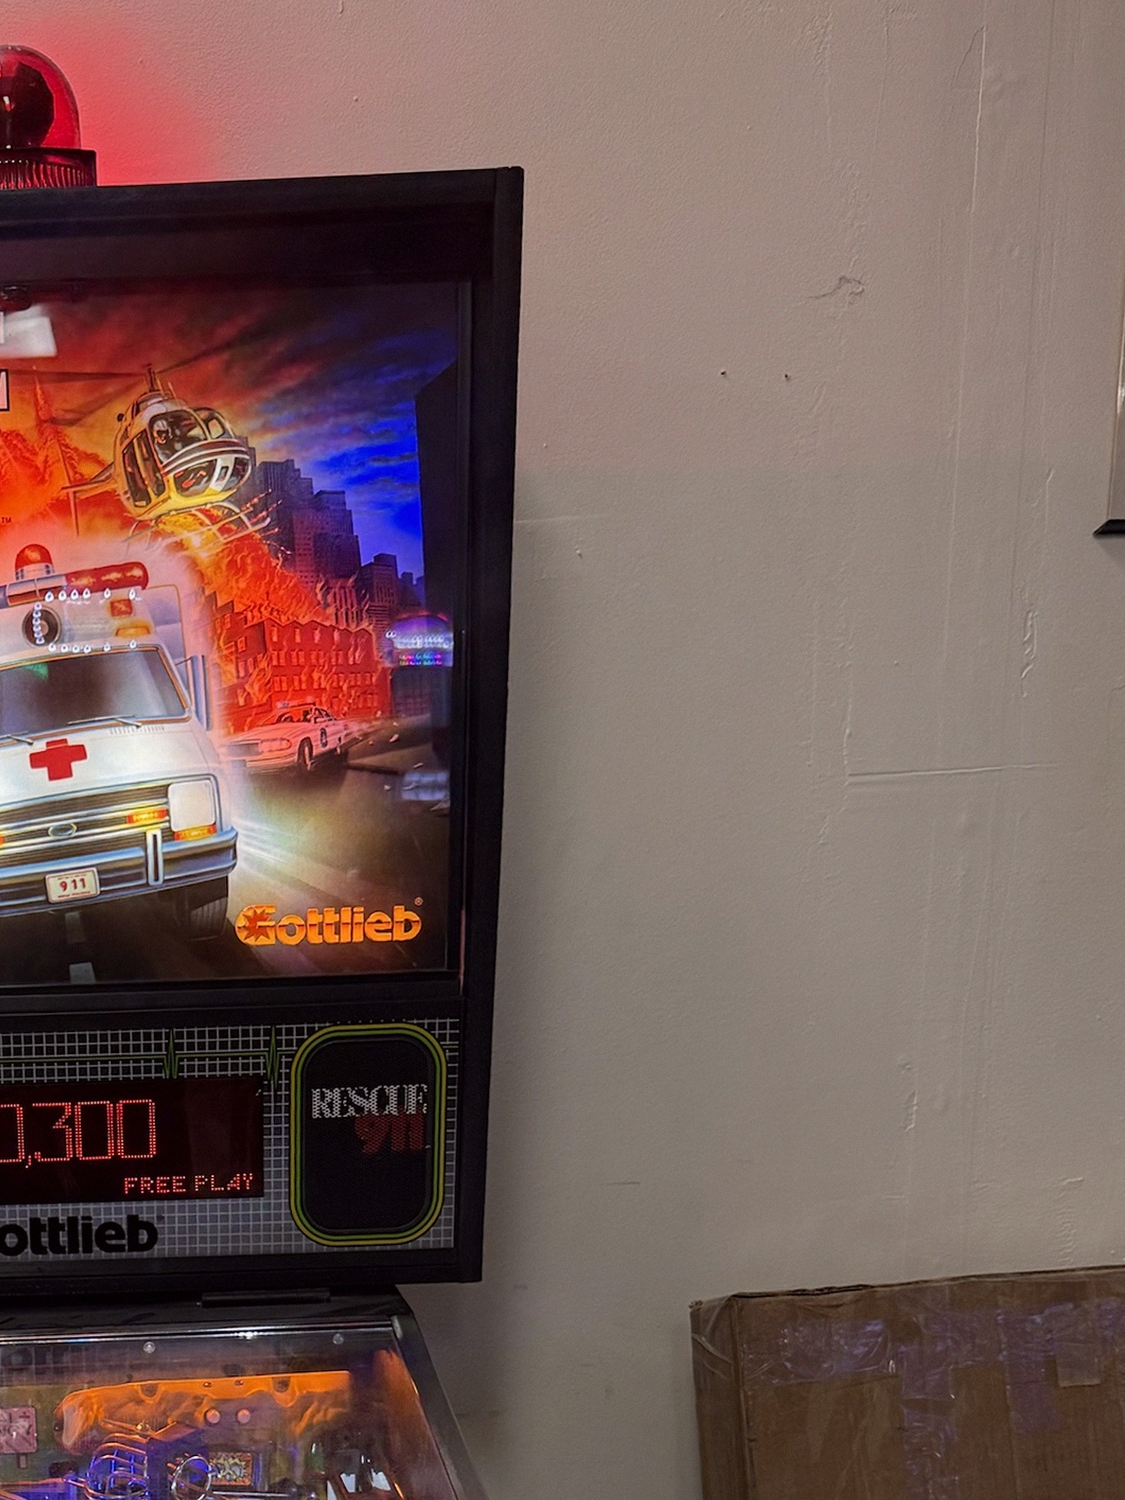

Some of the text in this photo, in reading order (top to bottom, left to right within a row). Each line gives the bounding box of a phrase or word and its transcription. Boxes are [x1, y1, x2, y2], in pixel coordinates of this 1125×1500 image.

[60, 877, 87, 892] 911
[235, 903, 423, 946] Gottlieb
[311, 1084, 428, 1118] RESCUE
[124, 1173, 253, 1195] FREE PLAY
